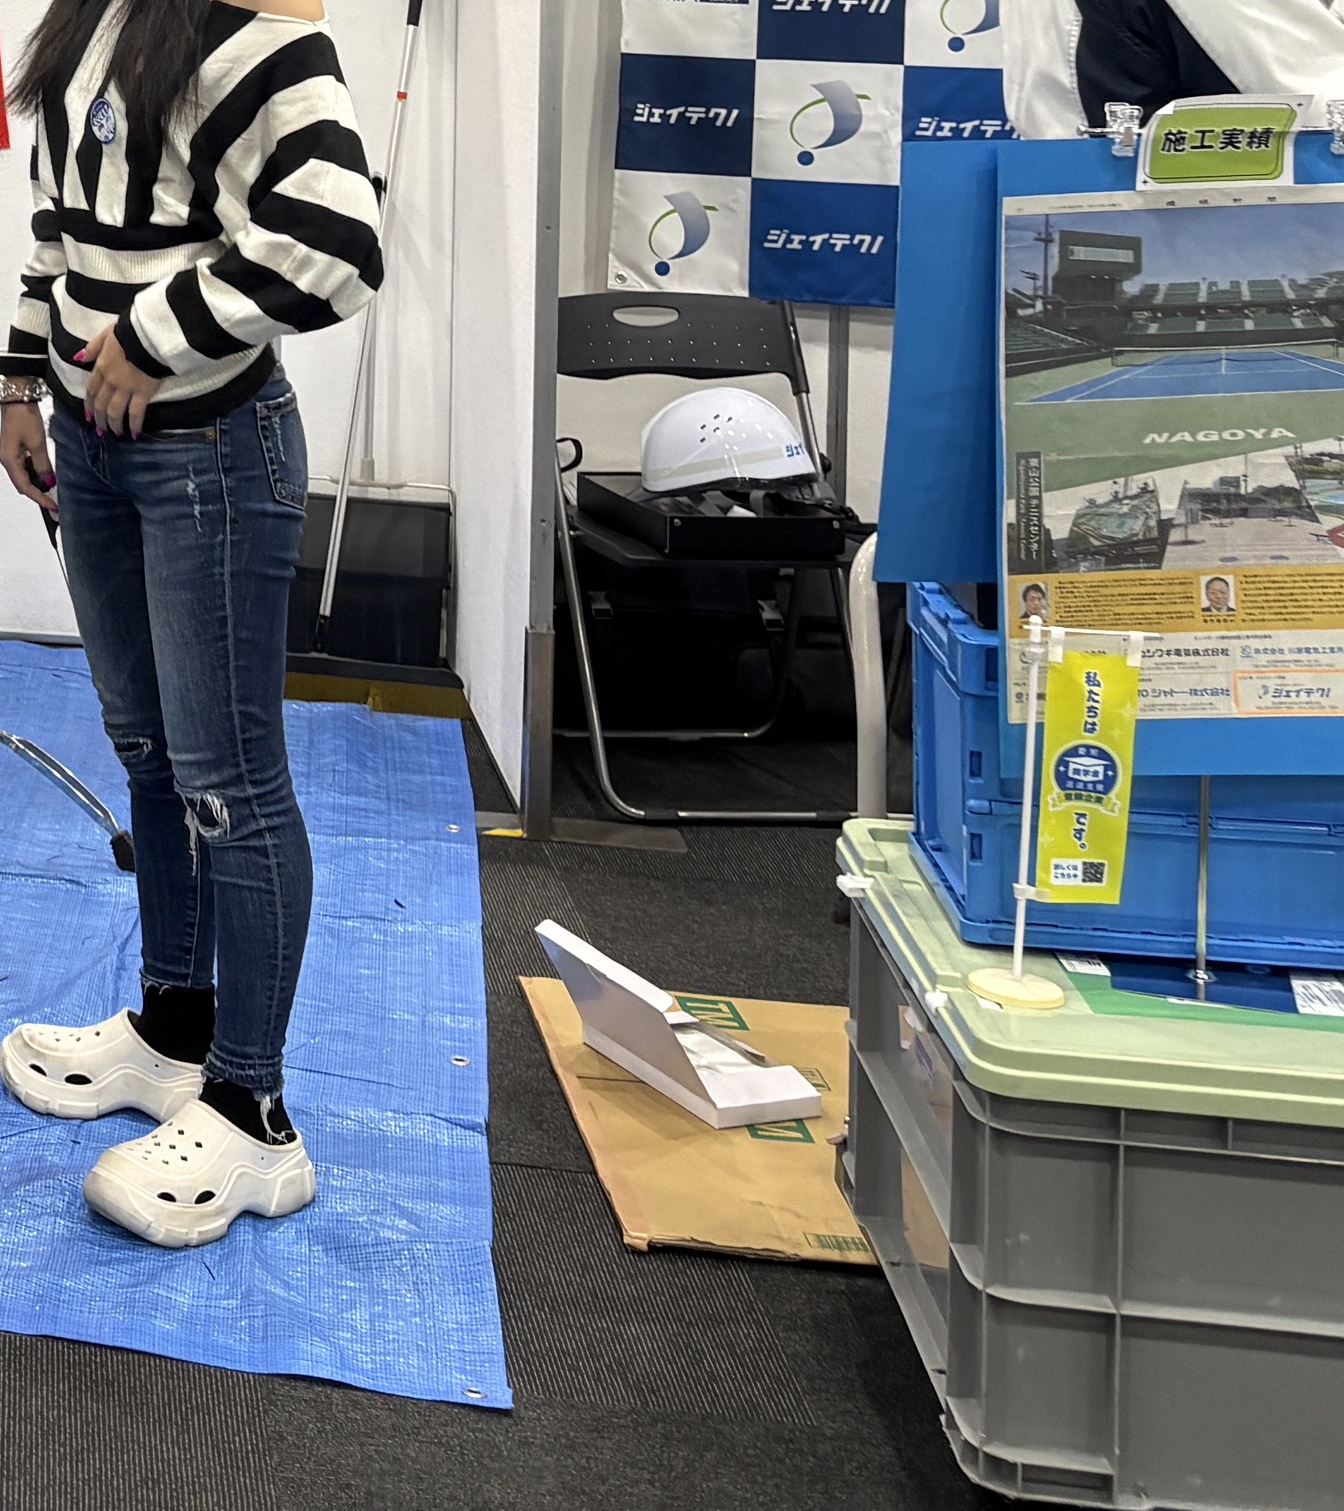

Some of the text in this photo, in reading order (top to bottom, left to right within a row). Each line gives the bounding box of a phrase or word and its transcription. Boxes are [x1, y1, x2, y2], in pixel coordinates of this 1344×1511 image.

[1160, 126, 1276, 154] 施工実績
[1142, 427, 1297, 445] NAGOYA
[1083, 670, 1102, 735] 私たちは
[1072, 811, 1088, 850] です。
